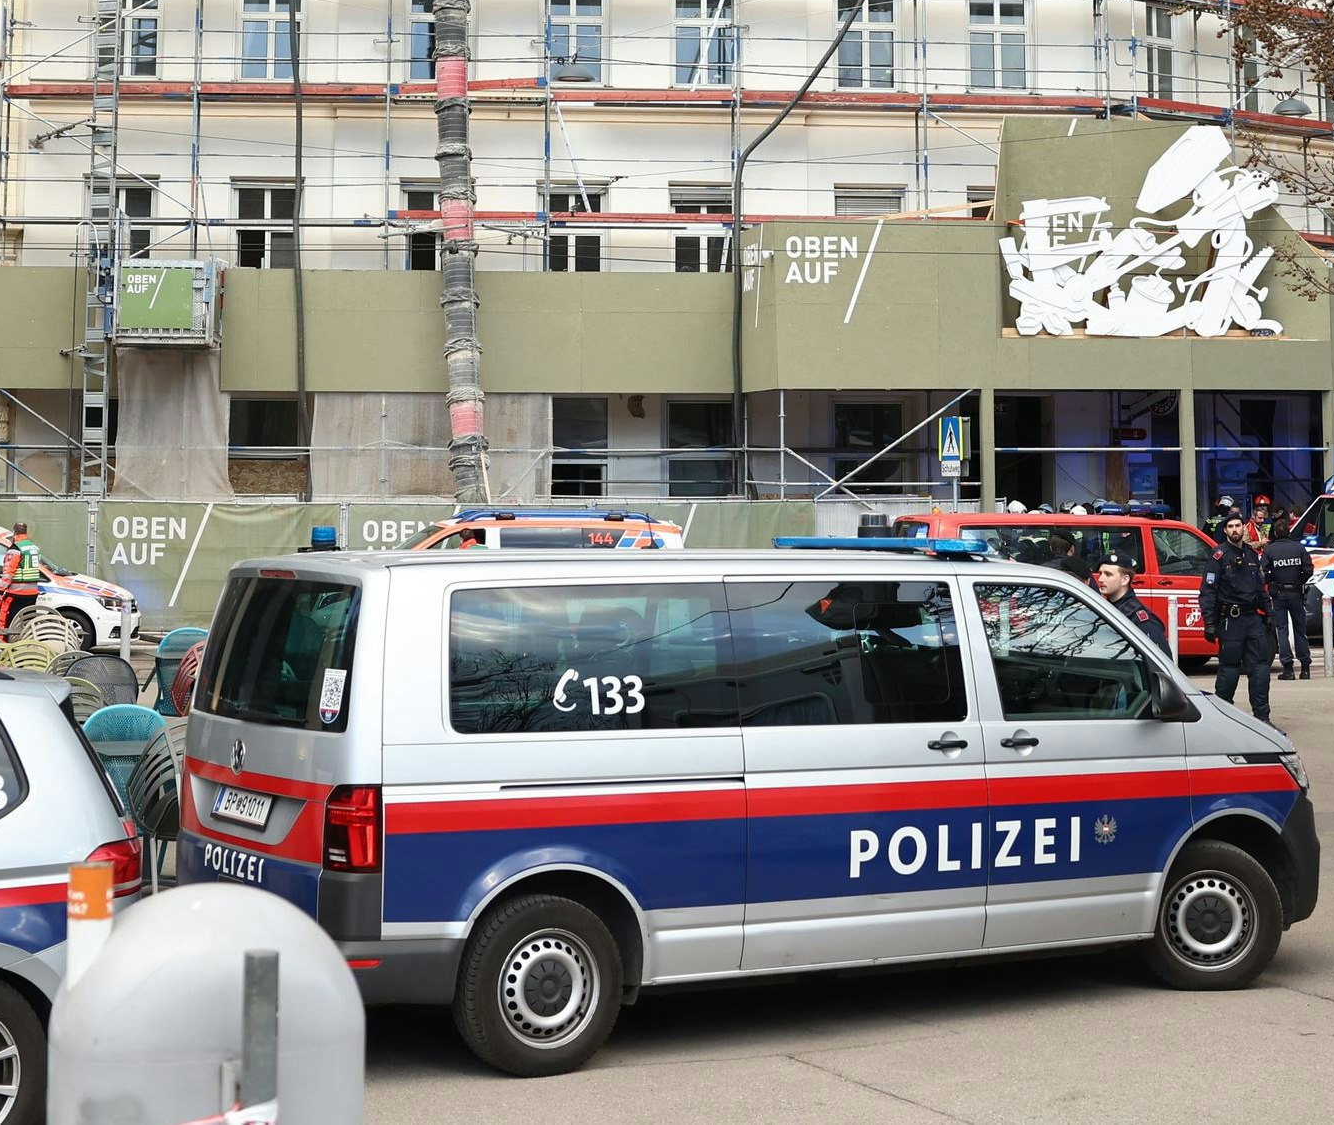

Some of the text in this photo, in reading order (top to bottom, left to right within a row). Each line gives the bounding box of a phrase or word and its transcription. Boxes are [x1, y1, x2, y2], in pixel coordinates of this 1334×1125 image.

[785, 235, 858, 259] OBEN
[126, 274, 157, 285] OBEN
[784, 261, 839, 284] AUF
[126, 283, 149, 294] AUF
[941, 462, 961, 474] Schulweg
[112, 516, 187, 540] OBEN
[587, 531, 614, 546] 144
[109, 542, 166, 566] AUF
[1273, 557, 1303, 567] POLIZEI
[582, 674, 645, 715] 133
[849, 816, 1081, 879] POLIZEI
[204, 842, 265, 883] POLIZEI
